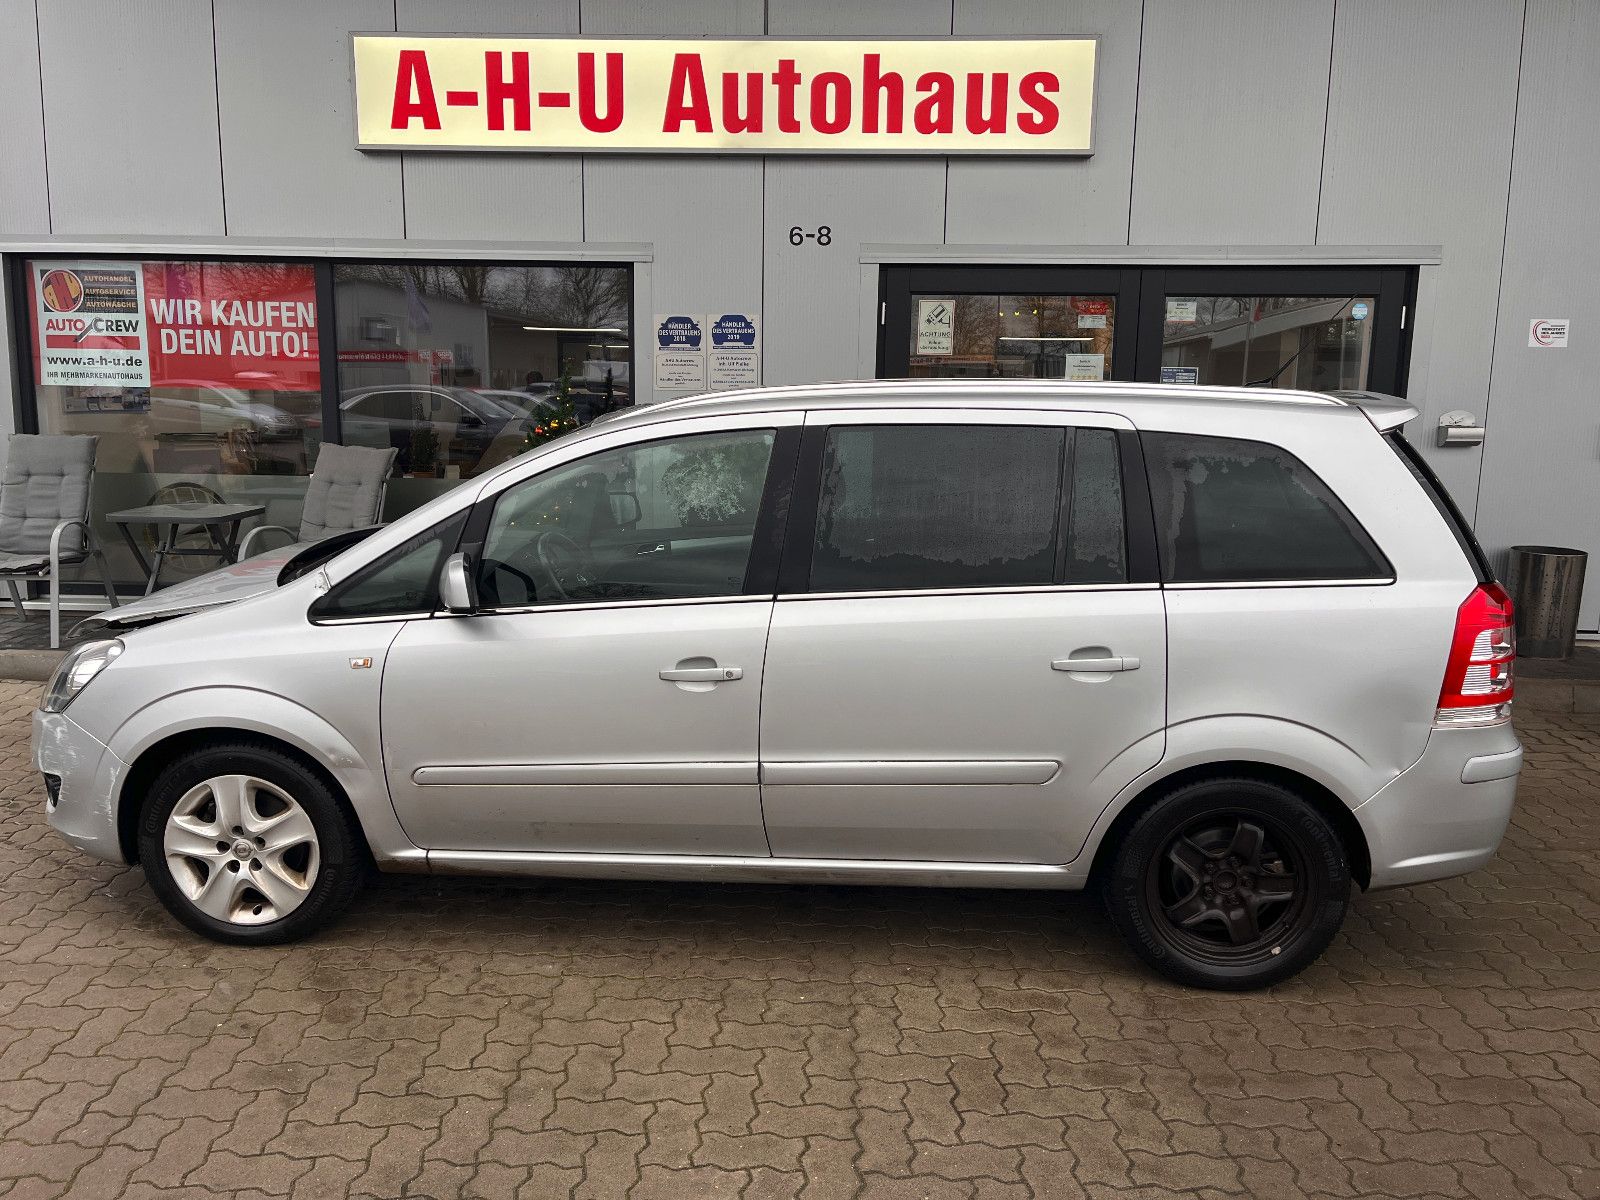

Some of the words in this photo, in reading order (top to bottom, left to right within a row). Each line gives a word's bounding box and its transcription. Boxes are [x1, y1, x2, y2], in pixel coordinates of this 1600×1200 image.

[390, 50, 624, 133] A-H-U
[662, 53, 1060, 135] Autohaus
[789, 226, 832, 246] 6-8
[83, 275, 134, 283] AUTOHANDEL
[84, 288, 136, 296] AUTOSERVICE
[151, 298, 202, 326] WIR
[210, 300, 315, 328] KAUFEN
[160, 328, 222, 356] DEIN
[230, 330, 309, 358] AUTO!
[47, 355, 143, 367] www.a-h-u.de
[47, 371, 59, 379] IHR
[60, 371, 143, 380] MEHRMARKENAUTOHAUS
